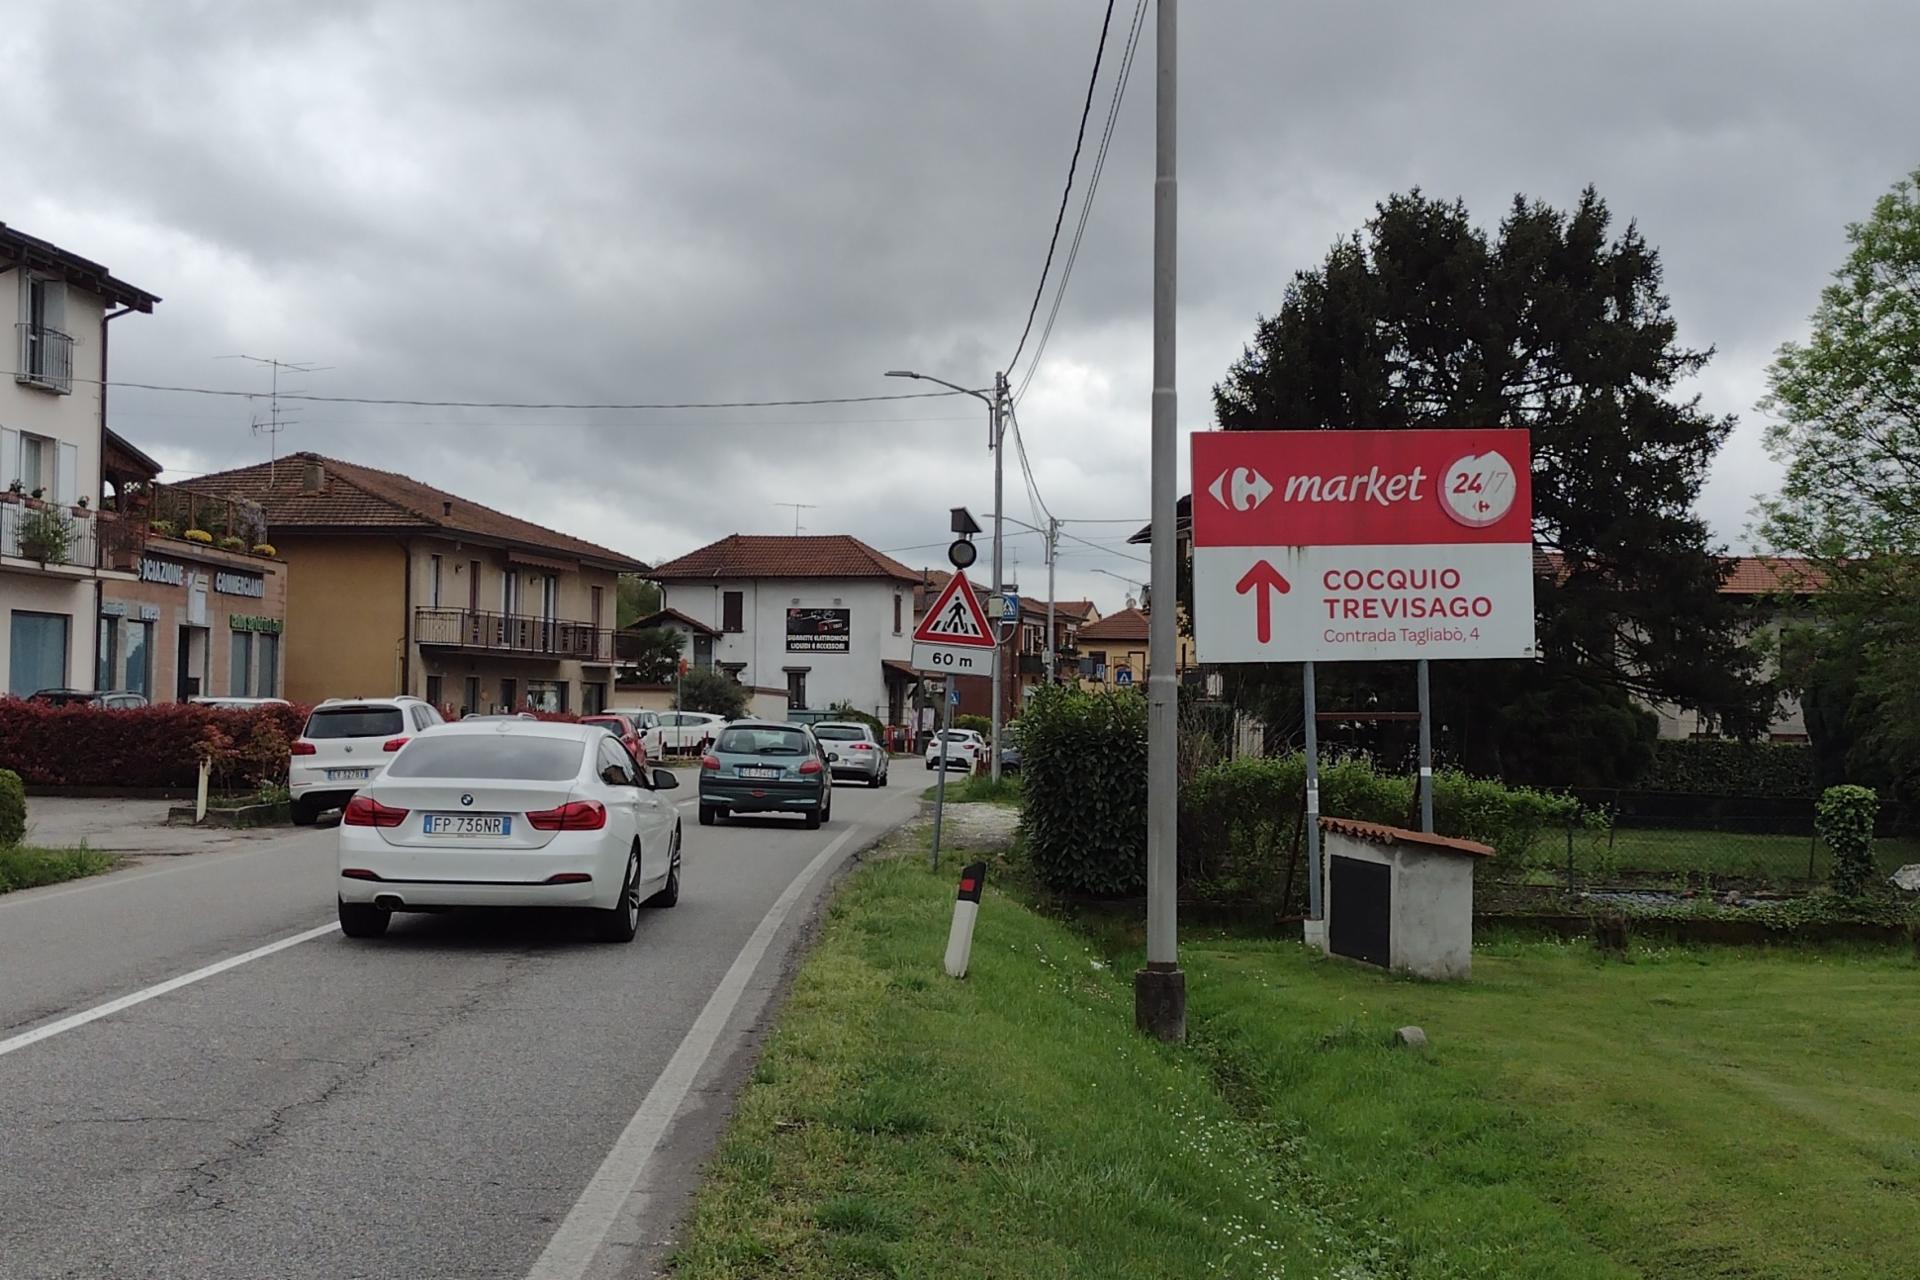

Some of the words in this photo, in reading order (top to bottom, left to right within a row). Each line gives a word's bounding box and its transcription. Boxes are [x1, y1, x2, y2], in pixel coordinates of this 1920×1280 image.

[1284, 466, 1427, 506] market
[1453, 471, 1509, 495] 24/7
[1323, 568, 1461, 591] COCQUIO
[1323, 597, 1492, 619] TREVISAGO
[1323, 628, 1397, 643] Contrada
[1400, 626, 1467, 645] Tagliabò,
[1470, 627, 1481, 641] 4
[932, 652, 953, 666] 60
[959, 656, 973, 668] m
[433, 817, 452, 832] FP
[456, 818, 501, 833] 736NR
